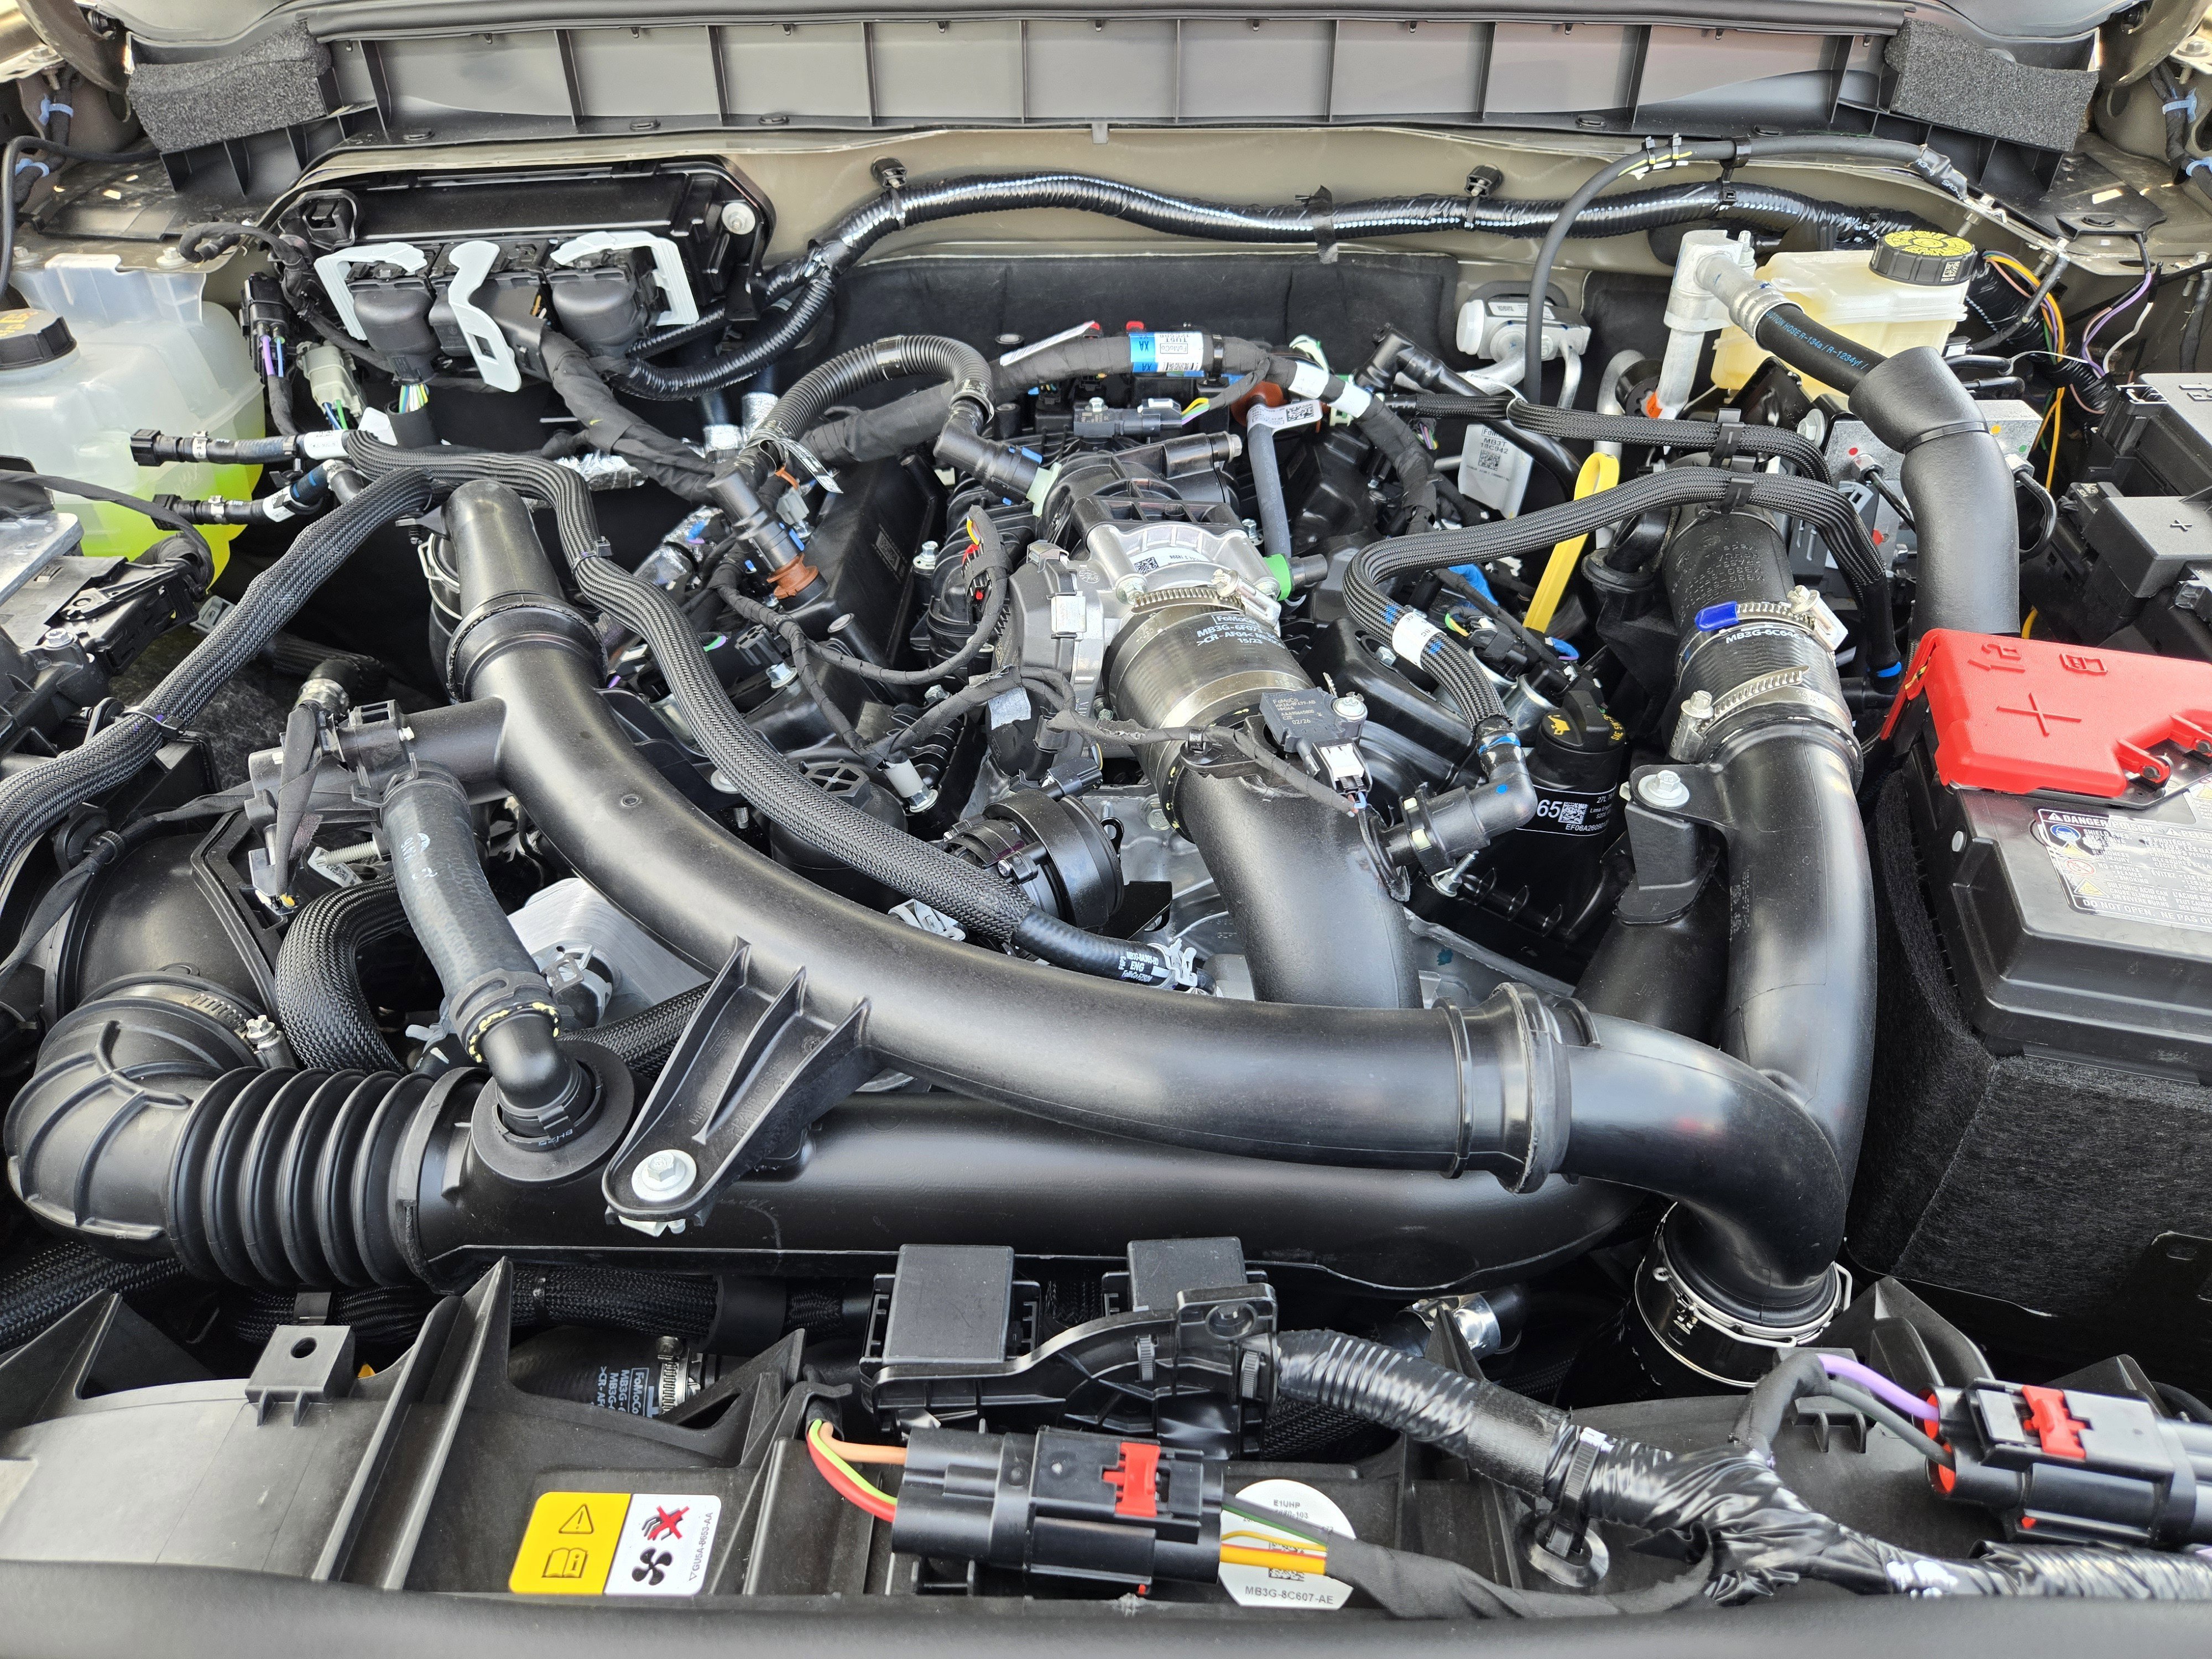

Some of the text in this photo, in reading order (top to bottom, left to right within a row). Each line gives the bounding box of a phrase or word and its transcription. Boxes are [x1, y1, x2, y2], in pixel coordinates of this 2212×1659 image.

[1766, 310, 1785, 326] UCTION
[1782, 322, 1801, 336] HOSE
[1799, 332, 1823, 349] R-134a
[1826, 346, 1864, 367] R-1234yf
[1139, 341, 1149, 352] XA
[1142, 363, 1152, 371] XA
[1484, 437, 1507, 447] MB3T
[1480, 443, 1509, 454] 18C942
[1216, 616, 1256, 624] FoMoCo
[1610, 731, 1623, 740] SAE
[1537, 799, 1563, 818] 65
[2180, 830, 2212, 840] PELIG
[2091, 849, 2130, 858] BLINDNESS
[2152, 857, 2192, 867] BLESSURES
[2114, 864, 2140, 873] SPARKS
[2106, 881, 2138, 891] SULFURIC
[2110, 888, 2167, 901] CAUSE BLINDNESS
[2123, 895, 2147, 904] SEVERE
[2101, 902, 2121, 911] NOT
[2124, 905, 2156, 916] OPEN.
[2160, 911, 2175, 919] NE
[2177, 914, 2198, 922] PAS
[1130, 961, 1145, 972] ENG
[597, 1366, 607, 1407] >CR-AF
[608, 1373, 619, 1410] MB3G-
[632, 1372, 644, 1414] FoMoCo
[1274, 1499, 1301, 1509] E1UHP
[692, 1512, 713, 1571] GU5A-8653-AA
[1245, 1585, 1334, 1605] MB3G-8C607-AE
